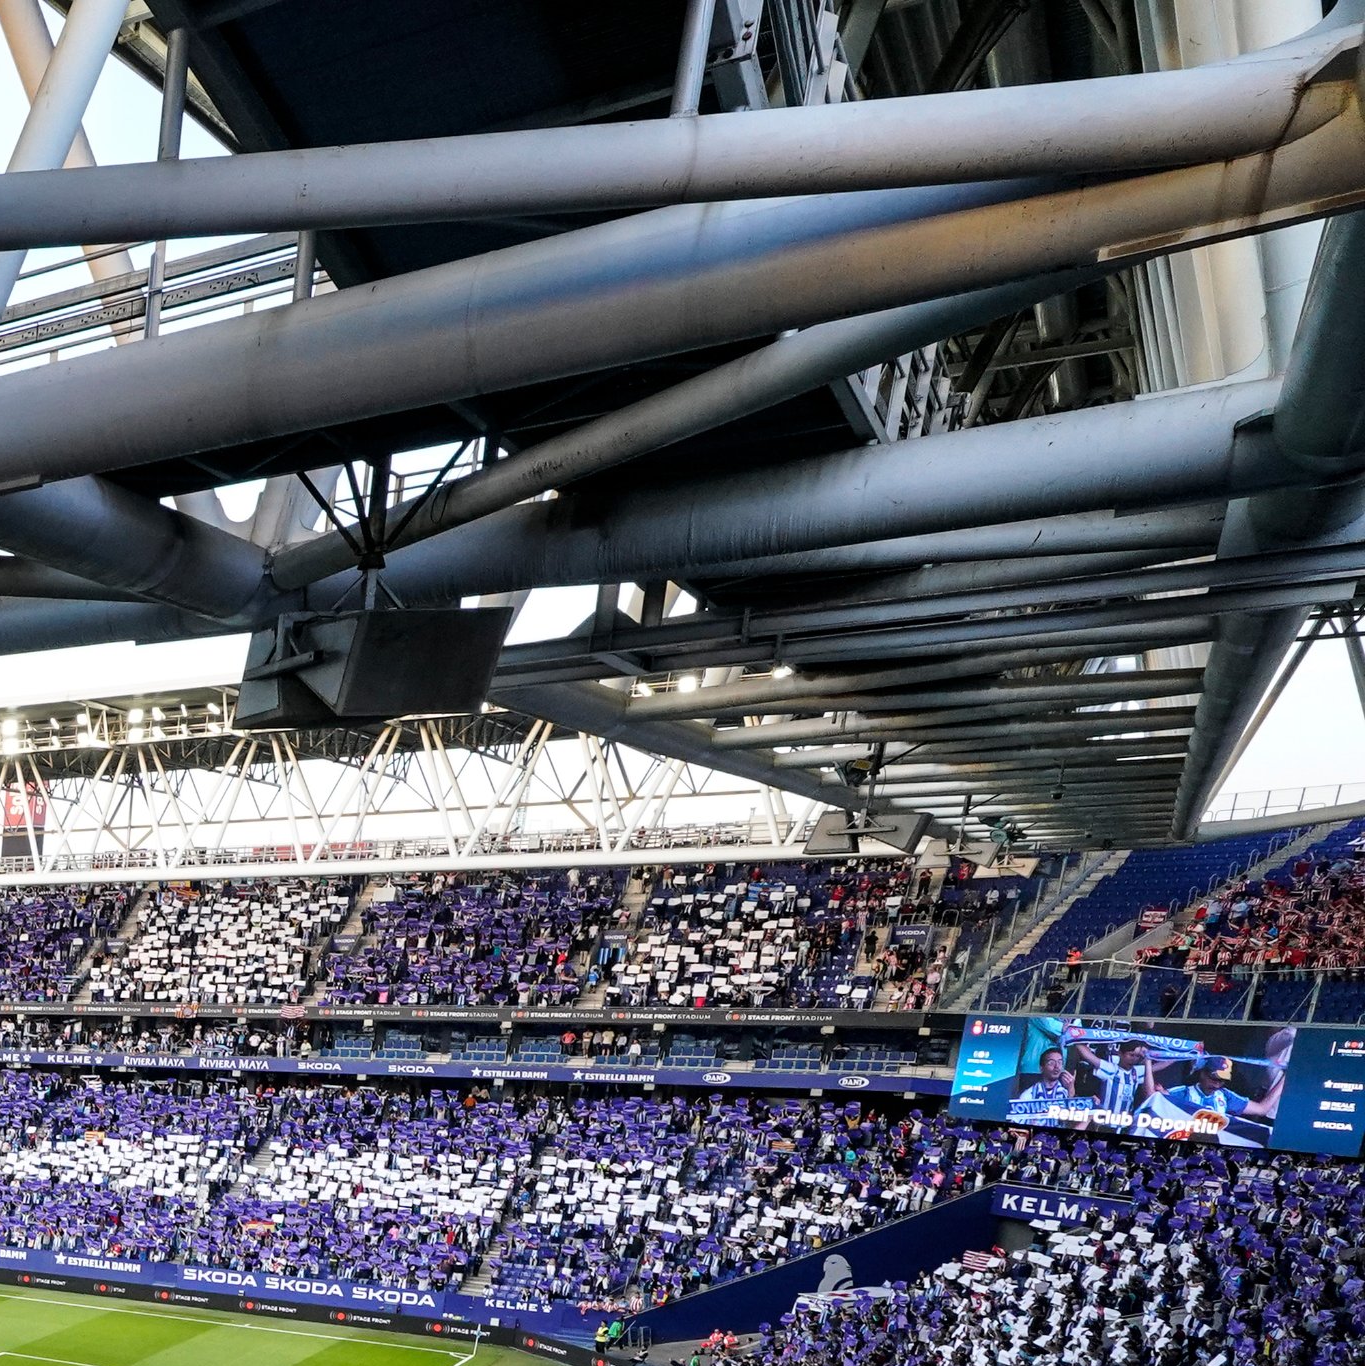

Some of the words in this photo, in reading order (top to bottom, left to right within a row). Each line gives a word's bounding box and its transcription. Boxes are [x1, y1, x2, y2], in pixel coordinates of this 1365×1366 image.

[987, 1026, 1011, 1035] 23/24
[1092, 1029, 1122, 1039] RCD
[47, 1055, 91, 1064] KELME
[124, 1056, 156, 1066] RIVIERA
[158, 1058, 185, 1067] MAYA
[199, 1058, 236, 1069] RIVIERA
[238, 1059, 269, 1070] MAYA
[297, 1062, 341, 1071] SKODA
[388, 1065, 435, 1074] SKODA
[522, 1071, 548, 1079] DAMM
[627, 1074, 655, 1082] DAMM
[1048, 1106, 1088, 1123] Reial
[1090, 1109, 1133, 1126] Club
[1137, 1111, 1218, 1135] Deportiu
[1313, 1121, 1352, 1131] SKODA
[0, 1249, 26, 1260] DAMM
[68, 1256, 110, 1270] ESTRELLA
[112, 1261, 141, 1273] DAMM
[183, 1268, 257, 1287] SKODA
[265, 1277, 344, 1298] SKODA
[352, 1286, 436, 1308] SKODA
[485, 1298, 538, 1312] KELME
[372, 1317, 391, 1325] FRONT
[450, 1327, 471, 1335] STAGE
[539, 1342, 553, 1351] STAGE
[552, 1346, 568, 1356] FRONT
